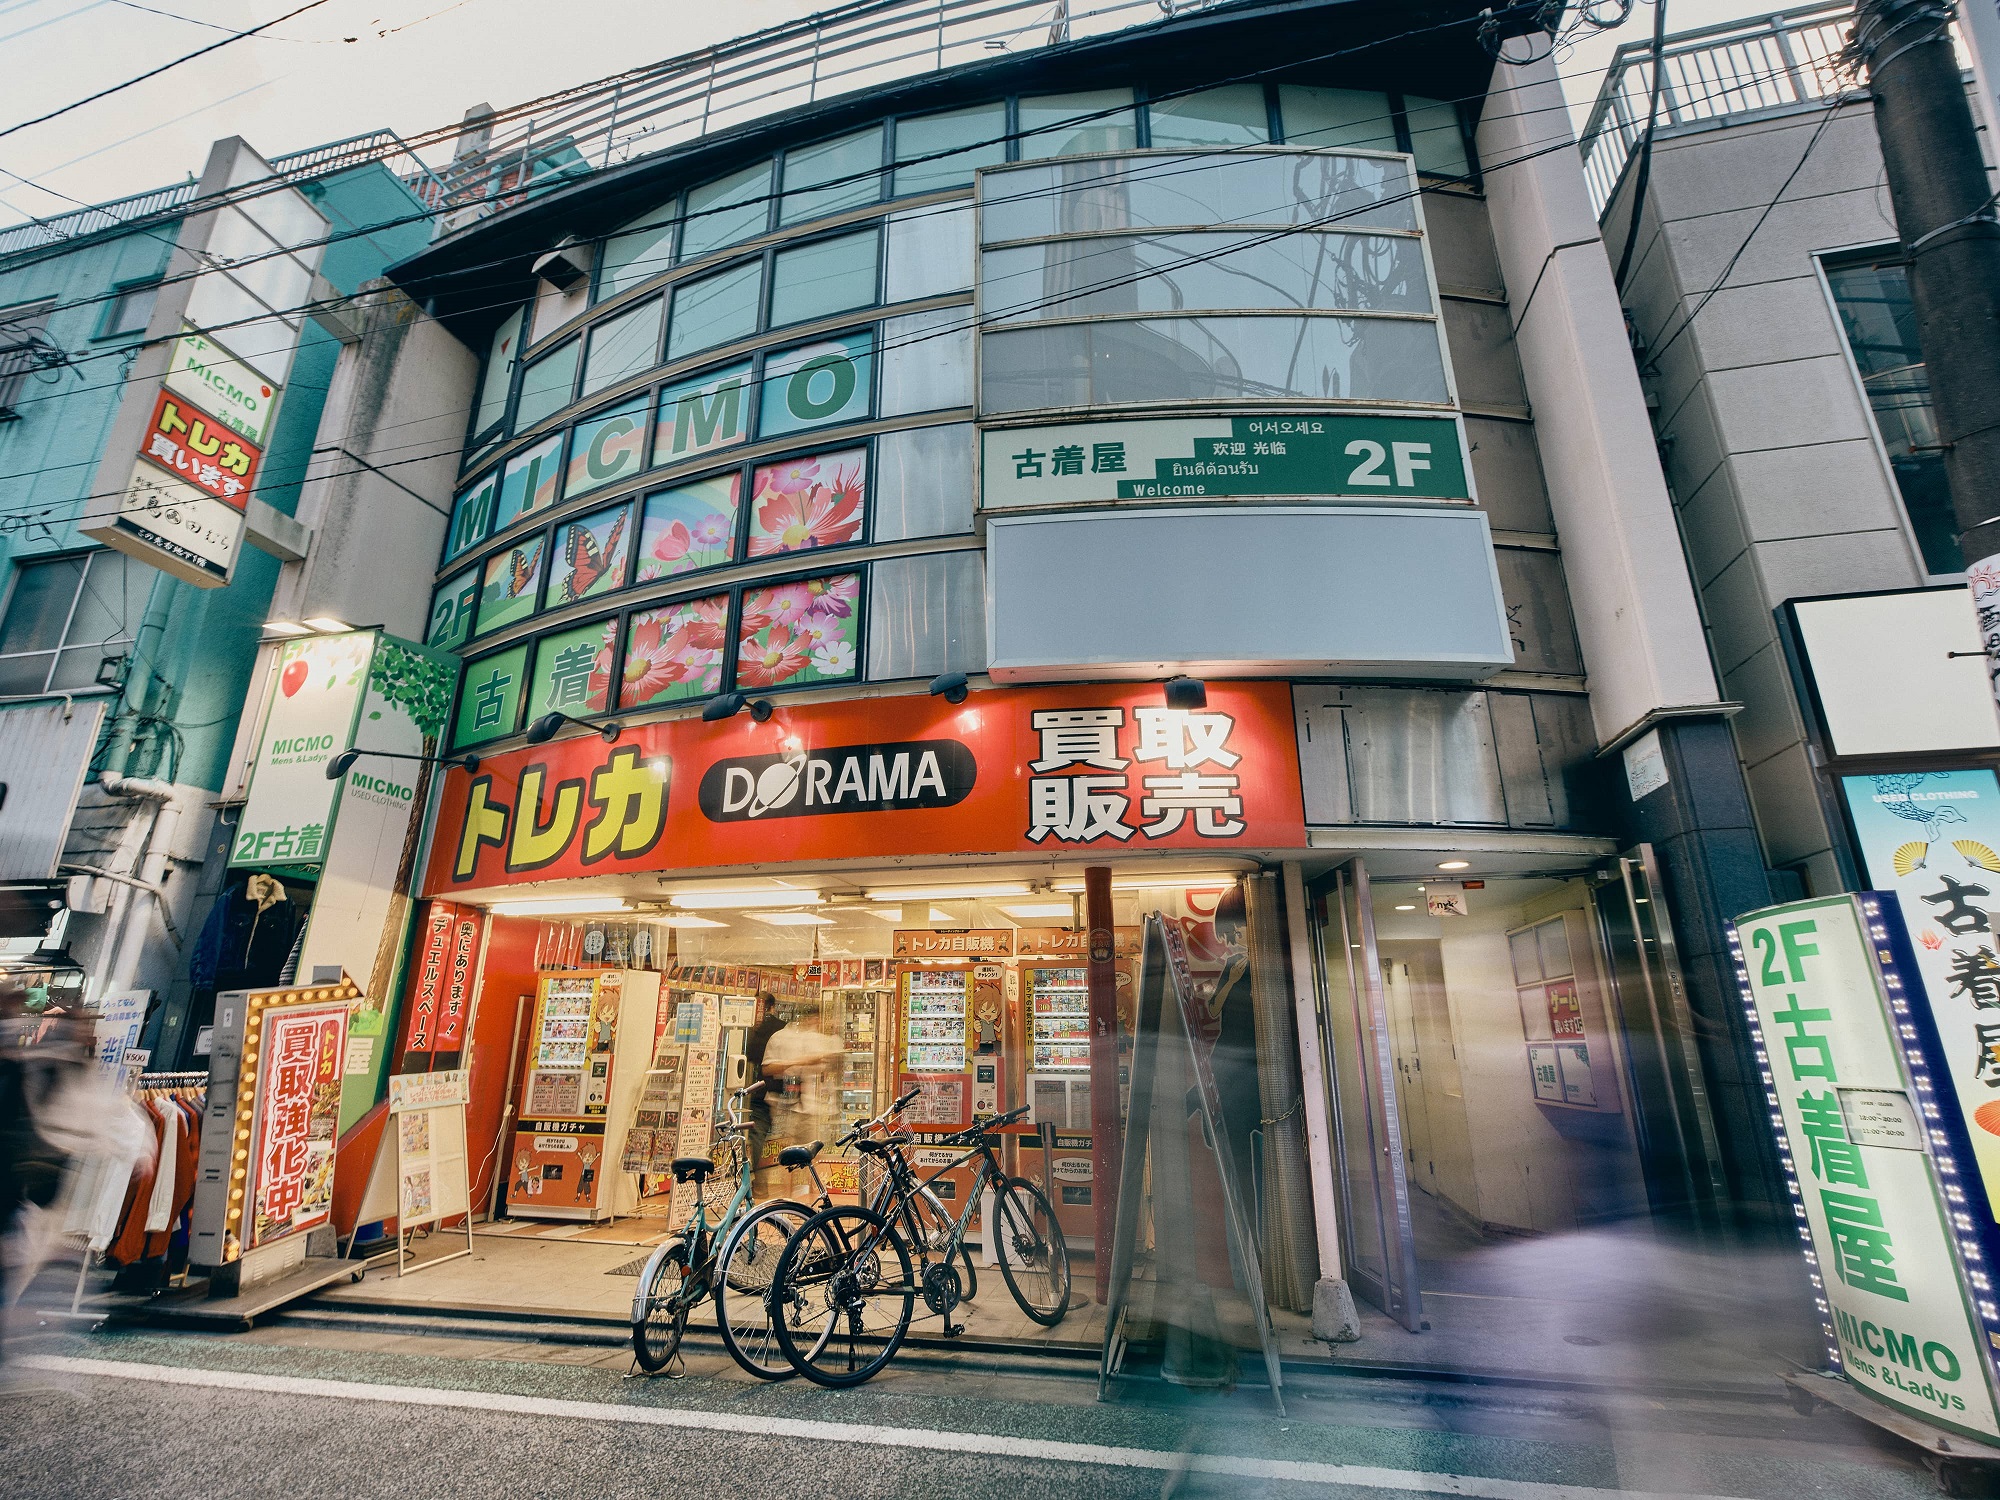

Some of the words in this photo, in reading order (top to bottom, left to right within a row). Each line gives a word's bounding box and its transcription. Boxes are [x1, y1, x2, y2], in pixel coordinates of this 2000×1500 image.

[184, 335, 209, 351] 2F
[187, 357, 258, 412] MICMO
[158, 400, 251, 476] トレカ
[1212, 441, 1247, 457] 欢迎
[1252, 440, 1287, 456] 光临
[1248, 420, 1325, 435] 어서오세요
[147, 432, 245, 497] 買います
[453, 354, 857, 556] MICMO
[1011, 440, 1128, 479] 古着屋
[1172, 458, 1259, 478] ยินดีต้อนรับ
[1347, 438, 1433, 487] 2F
[1132, 482, 1206, 497] Welcome
[429, 583, 476, 648] 2F
[472, 641, 597, 733] 古着
[271, 735, 334, 755] MICMO
[271, 757, 294, 766] Mens
[296, 753, 328, 764] &Ladys
[1028, 706, 1243, 774] 買取
[351, 772, 413, 801] MICMO
[351, 788, 372, 802] USED
[371, 794, 407, 811] CLOTHING
[721, 750, 948, 818] DORAMA
[1024, 772, 1247, 844] 販売
[1872, 792, 1909, 802] USED
[1909, 790, 1979, 800] CLOTHING
[453, 743, 672, 882] トレカ
[912, 937, 995, 951] トレカ自販機
[1037, 934, 1126, 951] トレカ自機
[1752, 918, 1820, 988] 2F
[412, 918, 446, 1049] デュエルスペース
[125, 1052, 146, 1062] ¥500
[319, 1029, 335, 1077] トレカ
[1536, 1065, 1557, 1083] 古着屋
[265, 1021, 317, 1222] 買取強化中
[534, 1121, 586, 1133] 自販機ガチャ
[1773, 993, 1909, 1303] 古着屋
[1834, 1306, 1961, 1382] MICMO
[1845, 1347, 1877, 1379] Mens
[1882, 1366, 1966, 1411] &Ladys
